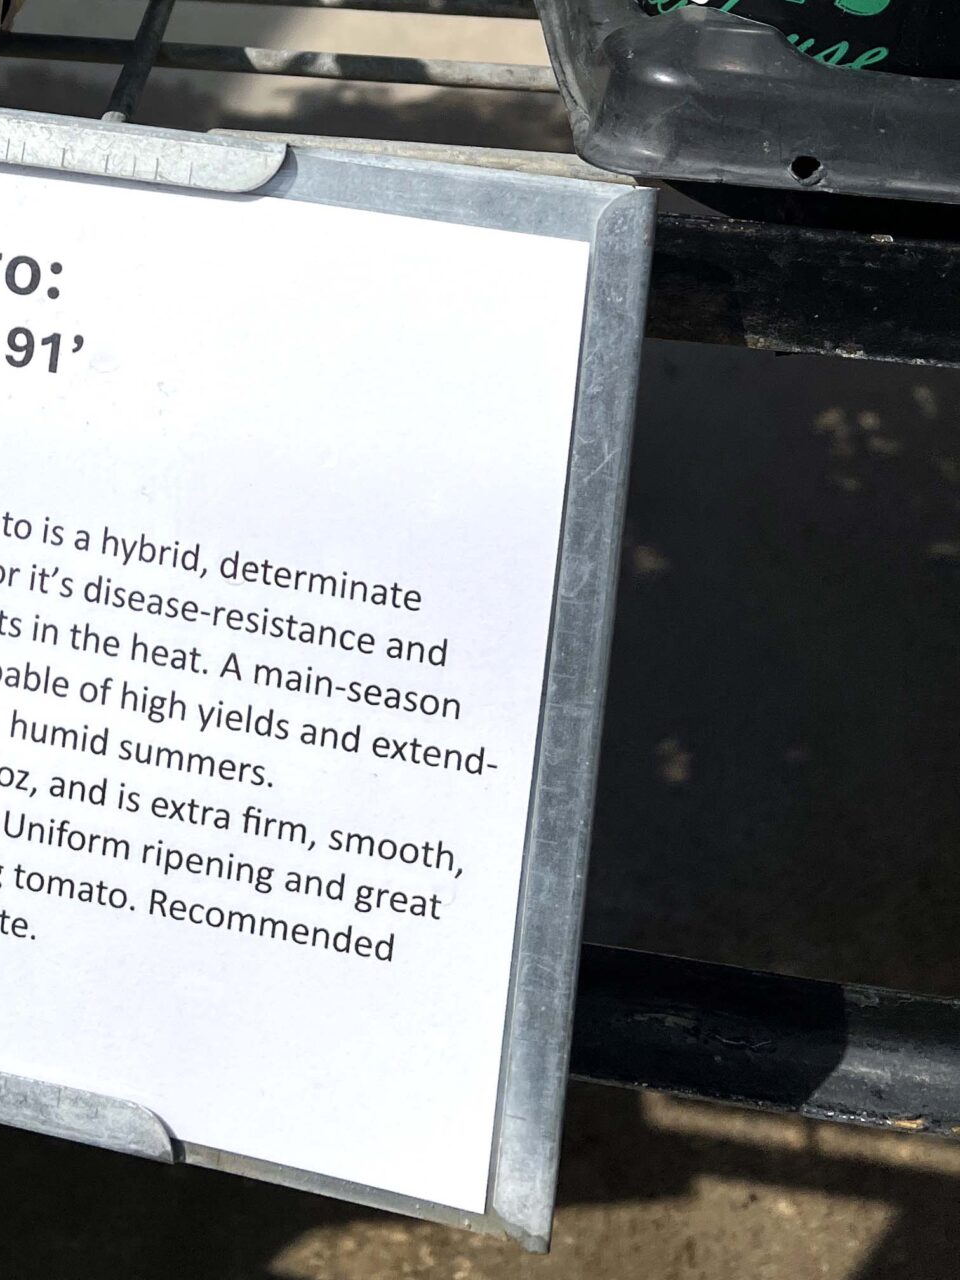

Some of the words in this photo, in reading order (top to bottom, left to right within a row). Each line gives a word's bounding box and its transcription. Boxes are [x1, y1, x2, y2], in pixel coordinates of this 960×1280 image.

[5, 326, 84, 374] 91’
[29, 566, 73, 598] it’s
[84, 575, 375, 655] disease-resistance
[386, 637, 448, 667] and
[42, 524, 64, 546] is
[74, 530, 90, 551] a
[101, 526, 207, 579] hybrid,
[220, 550, 422, 612] determinate
[32, 622, 58, 646] in
[70, 623, 120, 657] the
[131, 632, 208, 675] heat.
[219, 652, 242, 681] A
[254, 664, 461, 720] main-season
[10, 709, 109, 756] humid
[118, 740, 273, 788] summers.
[79, 677, 113, 706] of
[120, 681, 186, 724] high
[198, 700, 289, 740] yields
[300, 723, 361, 753] and
[372, 736, 498, 776] extend-
[4, 810, 130, 860] Uniform
[142, 844, 275, 894] ripening
[284, 871, 346, 901] and
[354, 885, 442, 920] great
[49, 776, 108, 806] and
[118, 789, 140, 813] is
[151, 797, 230, 830] extra
[242, 805, 316, 851] firm,
[328, 829, 463, 879] smooth,
[14, 864, 135, 911] tomato.
[149, 889, 395, 962] Recommended
